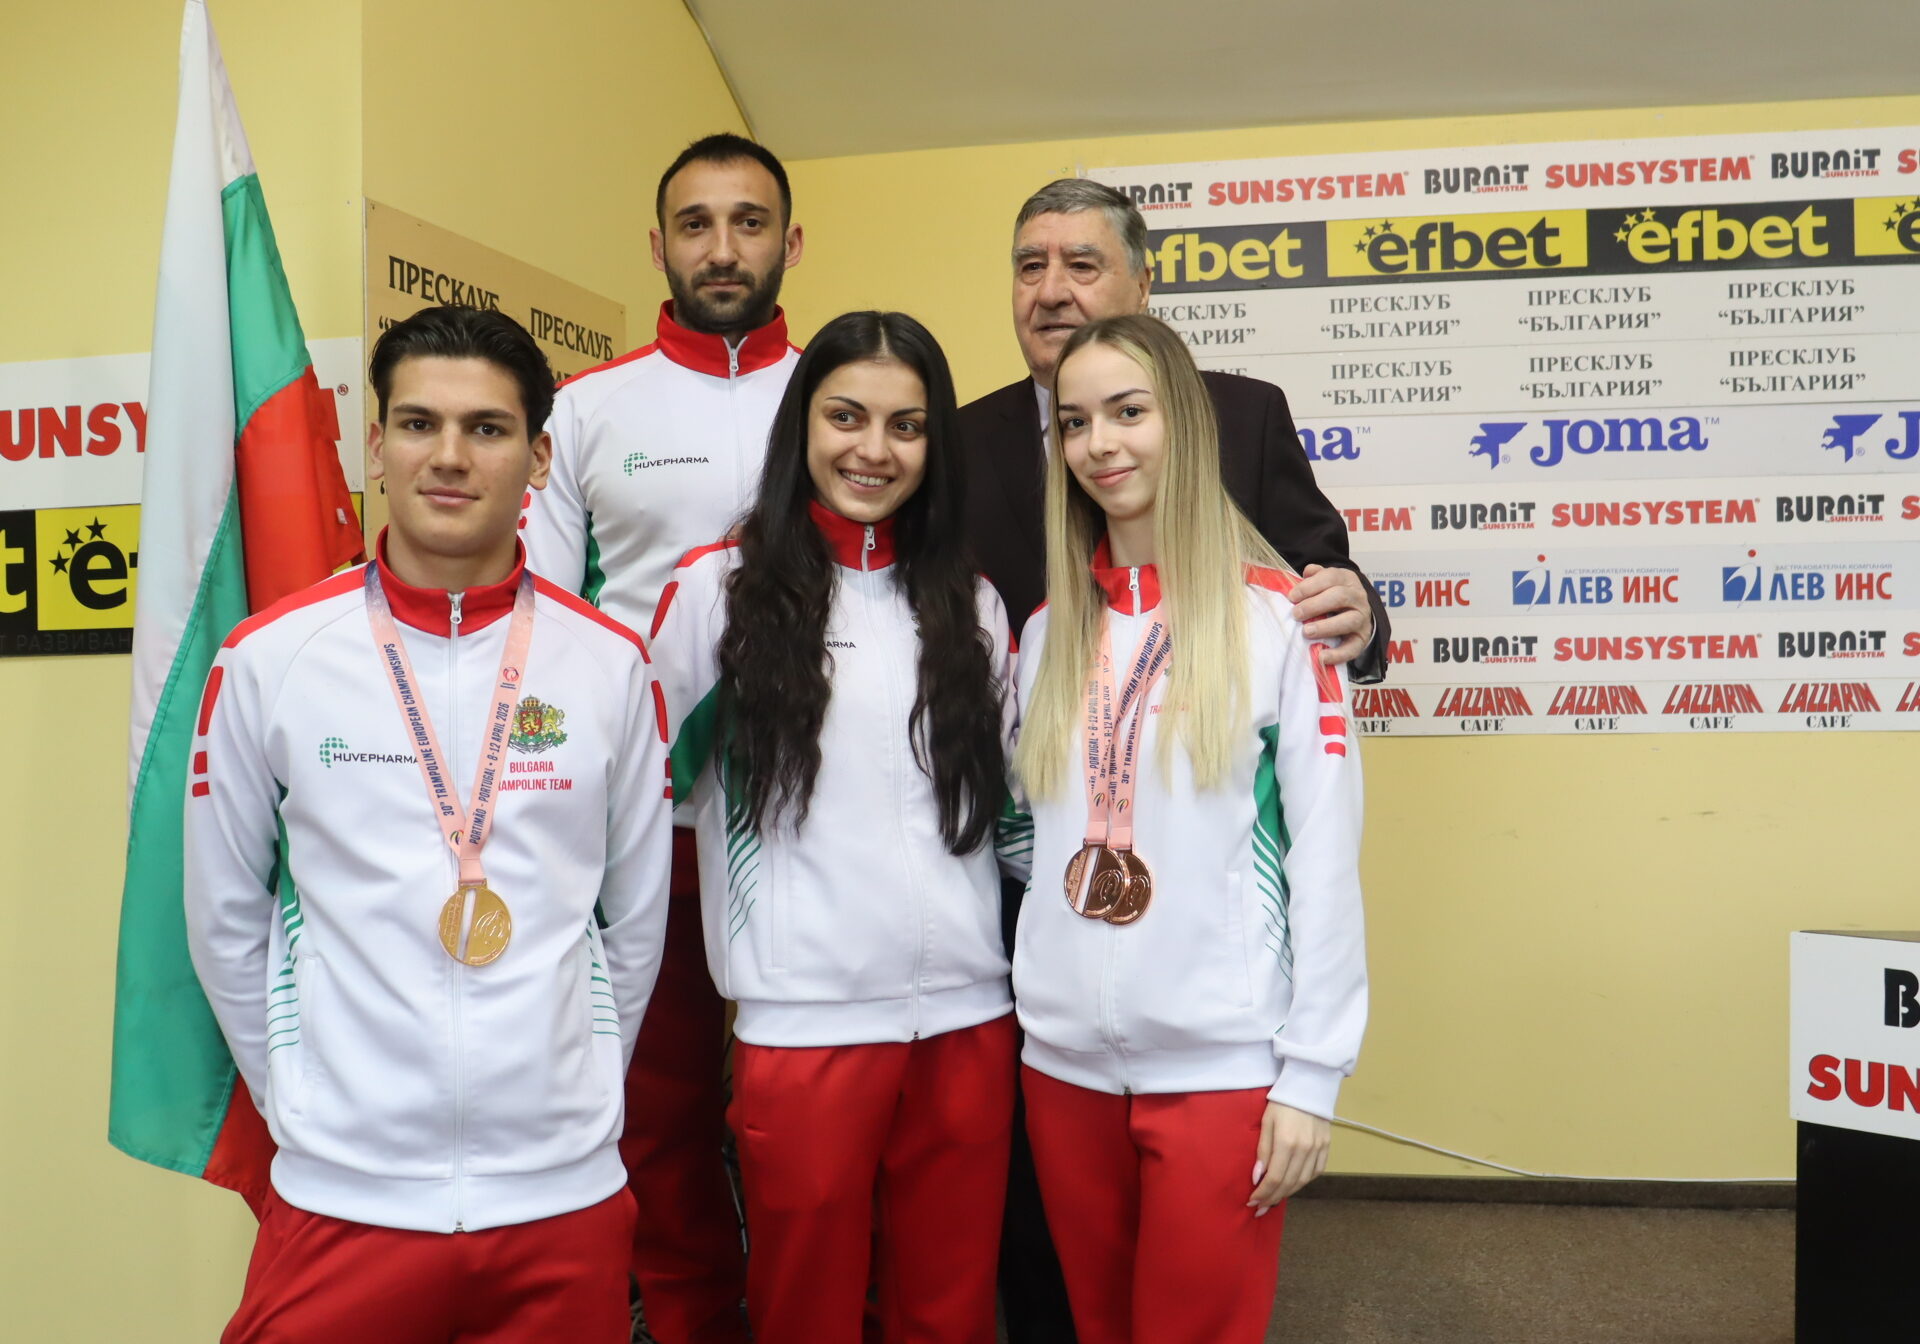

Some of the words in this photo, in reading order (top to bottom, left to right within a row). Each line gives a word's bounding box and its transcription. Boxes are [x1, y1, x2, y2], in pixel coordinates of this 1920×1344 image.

[1545, 156, 1752, 189] SUNSYSTEM
[1207, 172, 1406, 207] SUNSYSTEM
[1367, 216, 1562, 274] efbet
[1627, 205, 1829, 264] efbet
[389, 255, 500, 312] ПРЕСКЛУБ
[1528, 286, 1651, 306] ПРЕСКЛУБ
[1728, 279, 1855, 299] ПРЕСКЛУБ
[1330, 294, 1451, 314] ПРЕСКЛУБ
[530, 307, 613, 361] ПРЕСКЛУБ
[1331, 360, 1452, 380] ПРЕСКЛУБ
[1529, 353, 1653, 373] ПРЕСКЛУБ
[1729, 347, 1856, 367] ПРЕСКЛУБ
[634, 457, 710, 470] HUVEPHARMA
[1338, 507, 1413, 532] TEM
[1552, 499, 1757, 527] SUNSYSTEM
[1415, 579, 1470, 607] ИНС
[1558, 576, 1614, 604] ЛЕВ
[1622, 575, 1679, 603] ИНС
[1769, 572, 1825, 600] ЛЕВ
[1835, 572, 1892, 600] ИНС
[824, 641, 857, 649] ARMA
[1133, 622, 1163, 680] CHAMPIONSHIPS
[1553, 635, 1759, 661] SUNSYSTEM
[384, 643, 415, 705] CHAMPIONSHIPS
[1433, 687, 1534, 716] LAZZARIN
[1546, 685, 1648, 715] LAZZARIN
[1661, 684, 1764, 714] LAZZARIN
[1777, 682, 1882, 713] LAZZARIN
[406, 706, 430, 747] EUROPEAN
[1356, 720, 1391, 733] AFE
[421, 748, 448, 799] TRAMPOLINE
[509, 761, 554, 773] BULGARIA
[469, 808, 487, 845] PORTIMÃO
[478, 768, 496, 802] PORTUGAL
[491, 723, 505, 743] APRIL
[550, 778, 573, 790] TEAM
